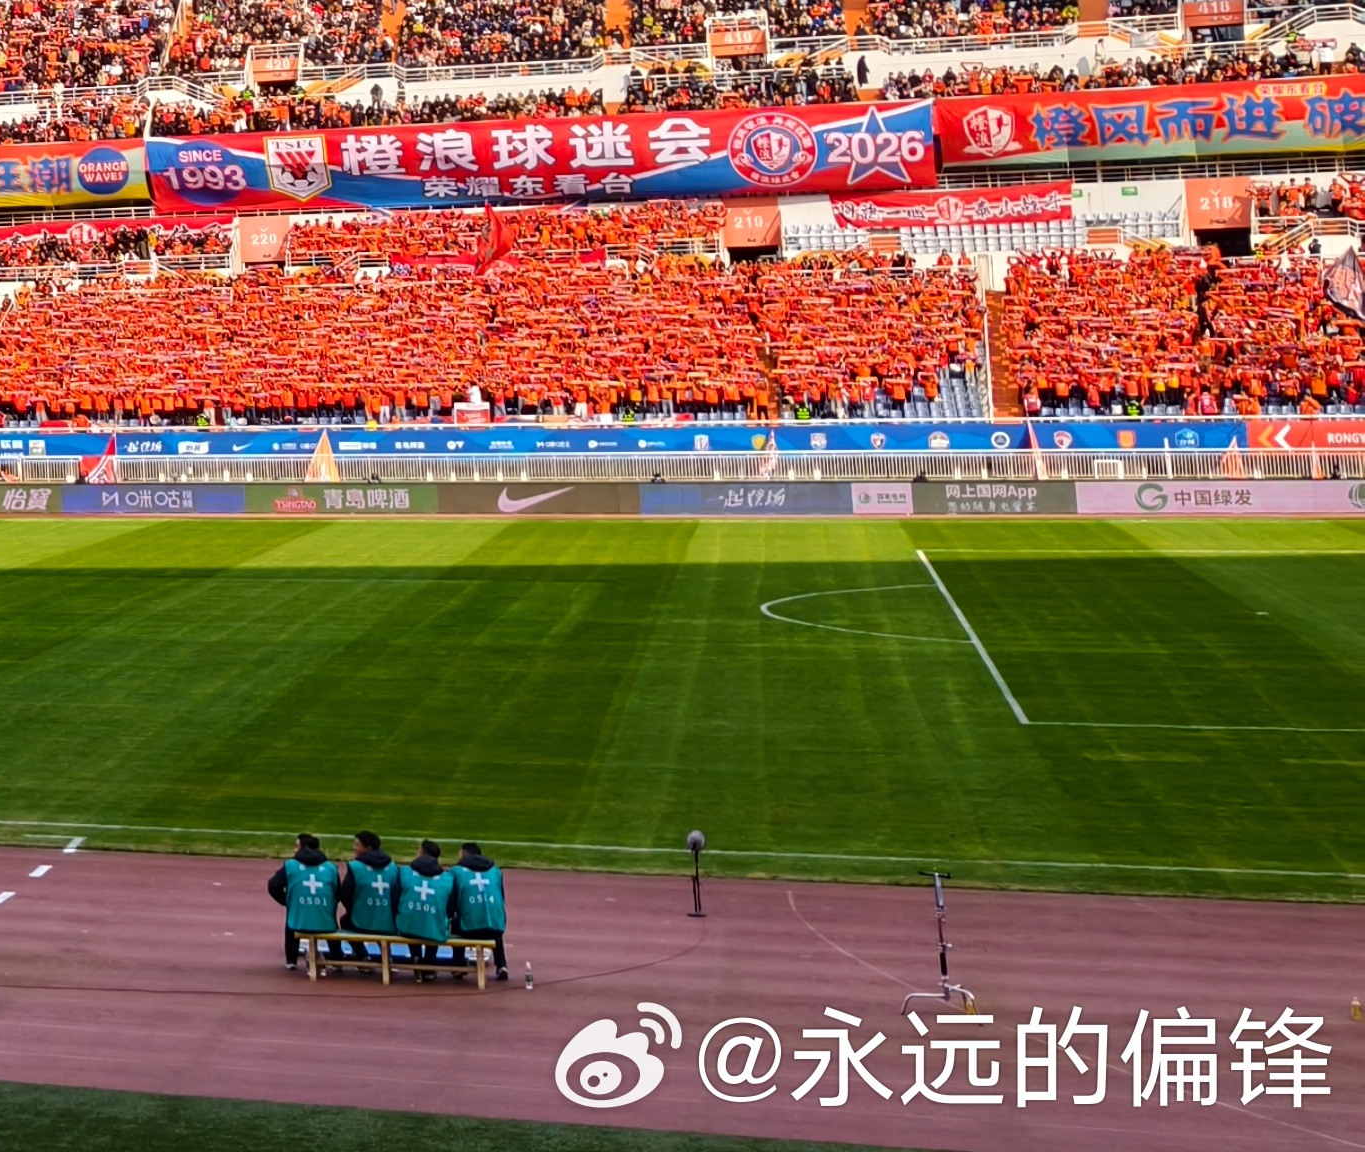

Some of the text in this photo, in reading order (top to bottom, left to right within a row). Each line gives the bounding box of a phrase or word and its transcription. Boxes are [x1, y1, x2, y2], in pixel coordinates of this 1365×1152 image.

[1030, 91, 1286, 149] 橙风而进
[271, 138, 317, 150] TSFC
[340, 117, 712, 176] 橙浪球迷会
[826, 130, 925, 164] 2026
[179, 149, 223, 163] SINCE
[79, 162, 127, 174] ORANGE
[83, 171, 127, 183] WAVES
[162, 164, 248, 191] 1993
[422, 173, 633, 198] 荣耀东看台
[252, 234, 278, 246] 220
[946, 484, 1038, 500] 网上国网App
[1174, 489, 1253, 507] 中国绿发
[275, 500, 317, 511] TSINGTAO
